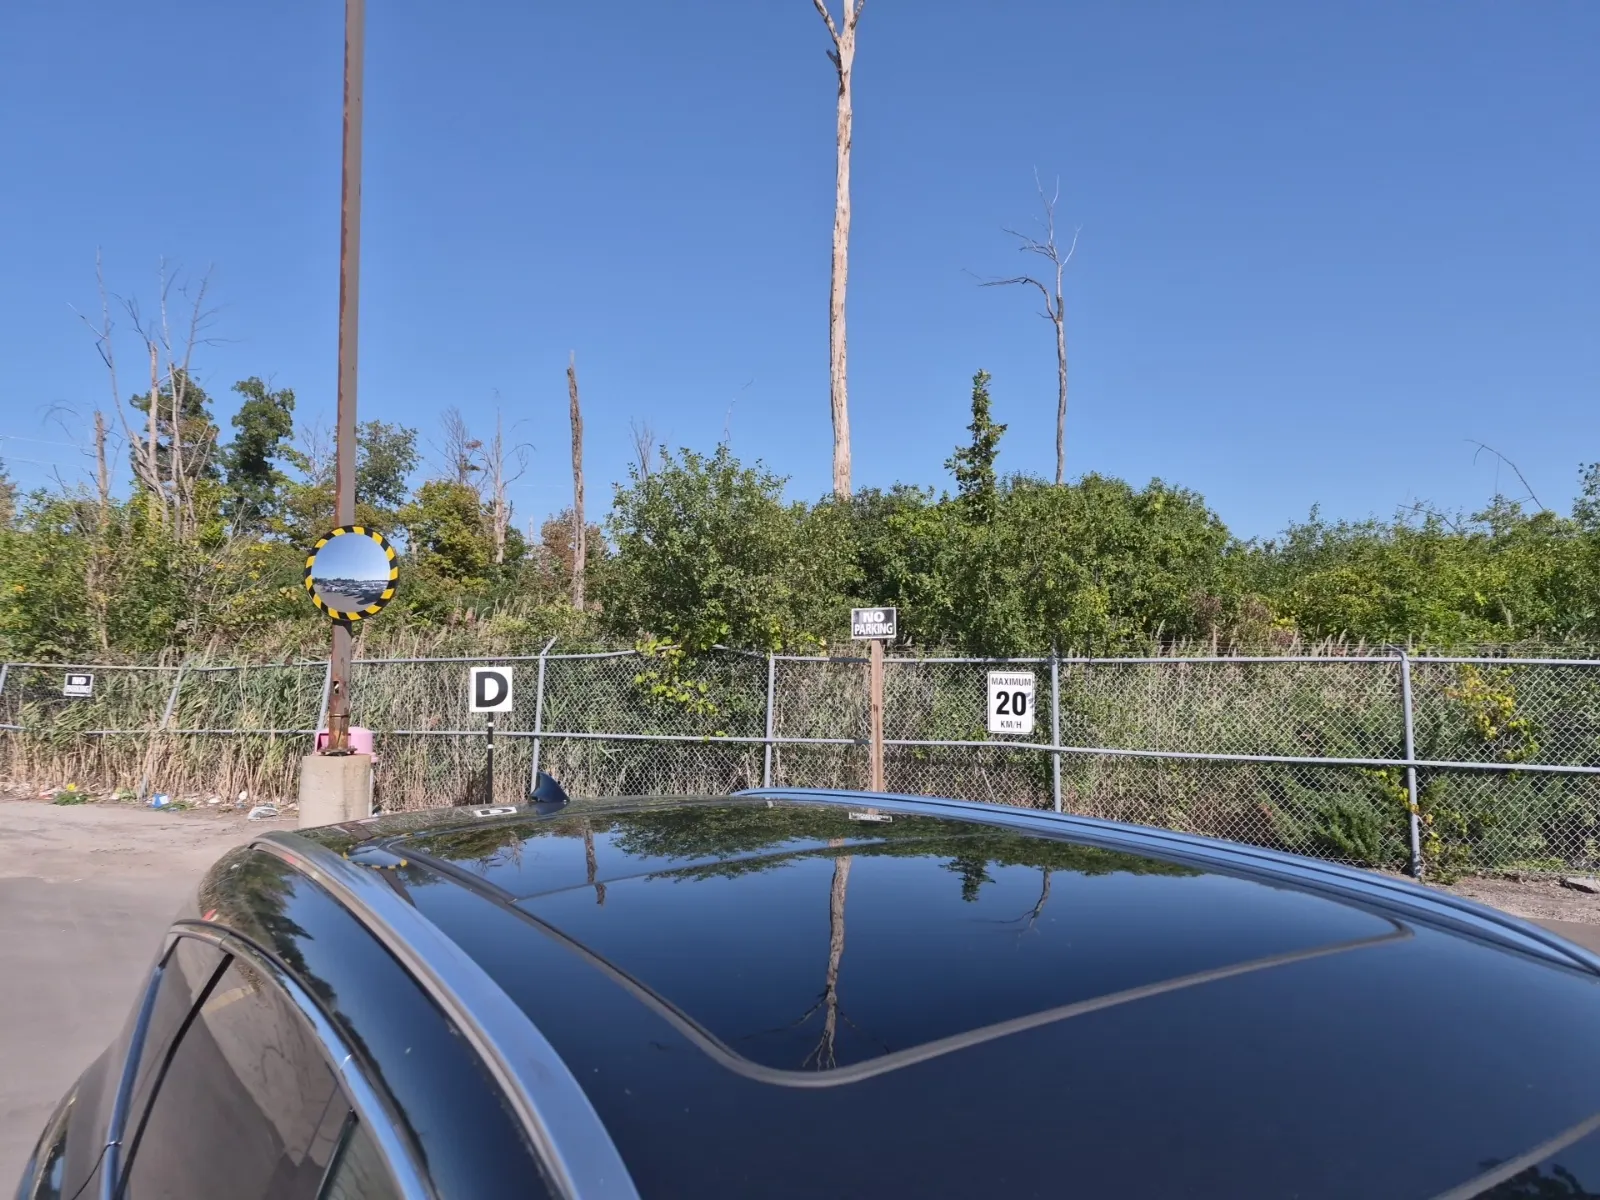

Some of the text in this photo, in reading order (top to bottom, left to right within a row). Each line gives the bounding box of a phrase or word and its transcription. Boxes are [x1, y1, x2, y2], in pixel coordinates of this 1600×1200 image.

[862, 611, 885, 623] NO
[854, 623, 893, 635] PARKING
[991, 677, 1032, 687] MAXIMUM
[475, 671, 509, 708] D
[995, 690, 1027, 717] 20
[1000, 720, 1022, 729] KM/H
